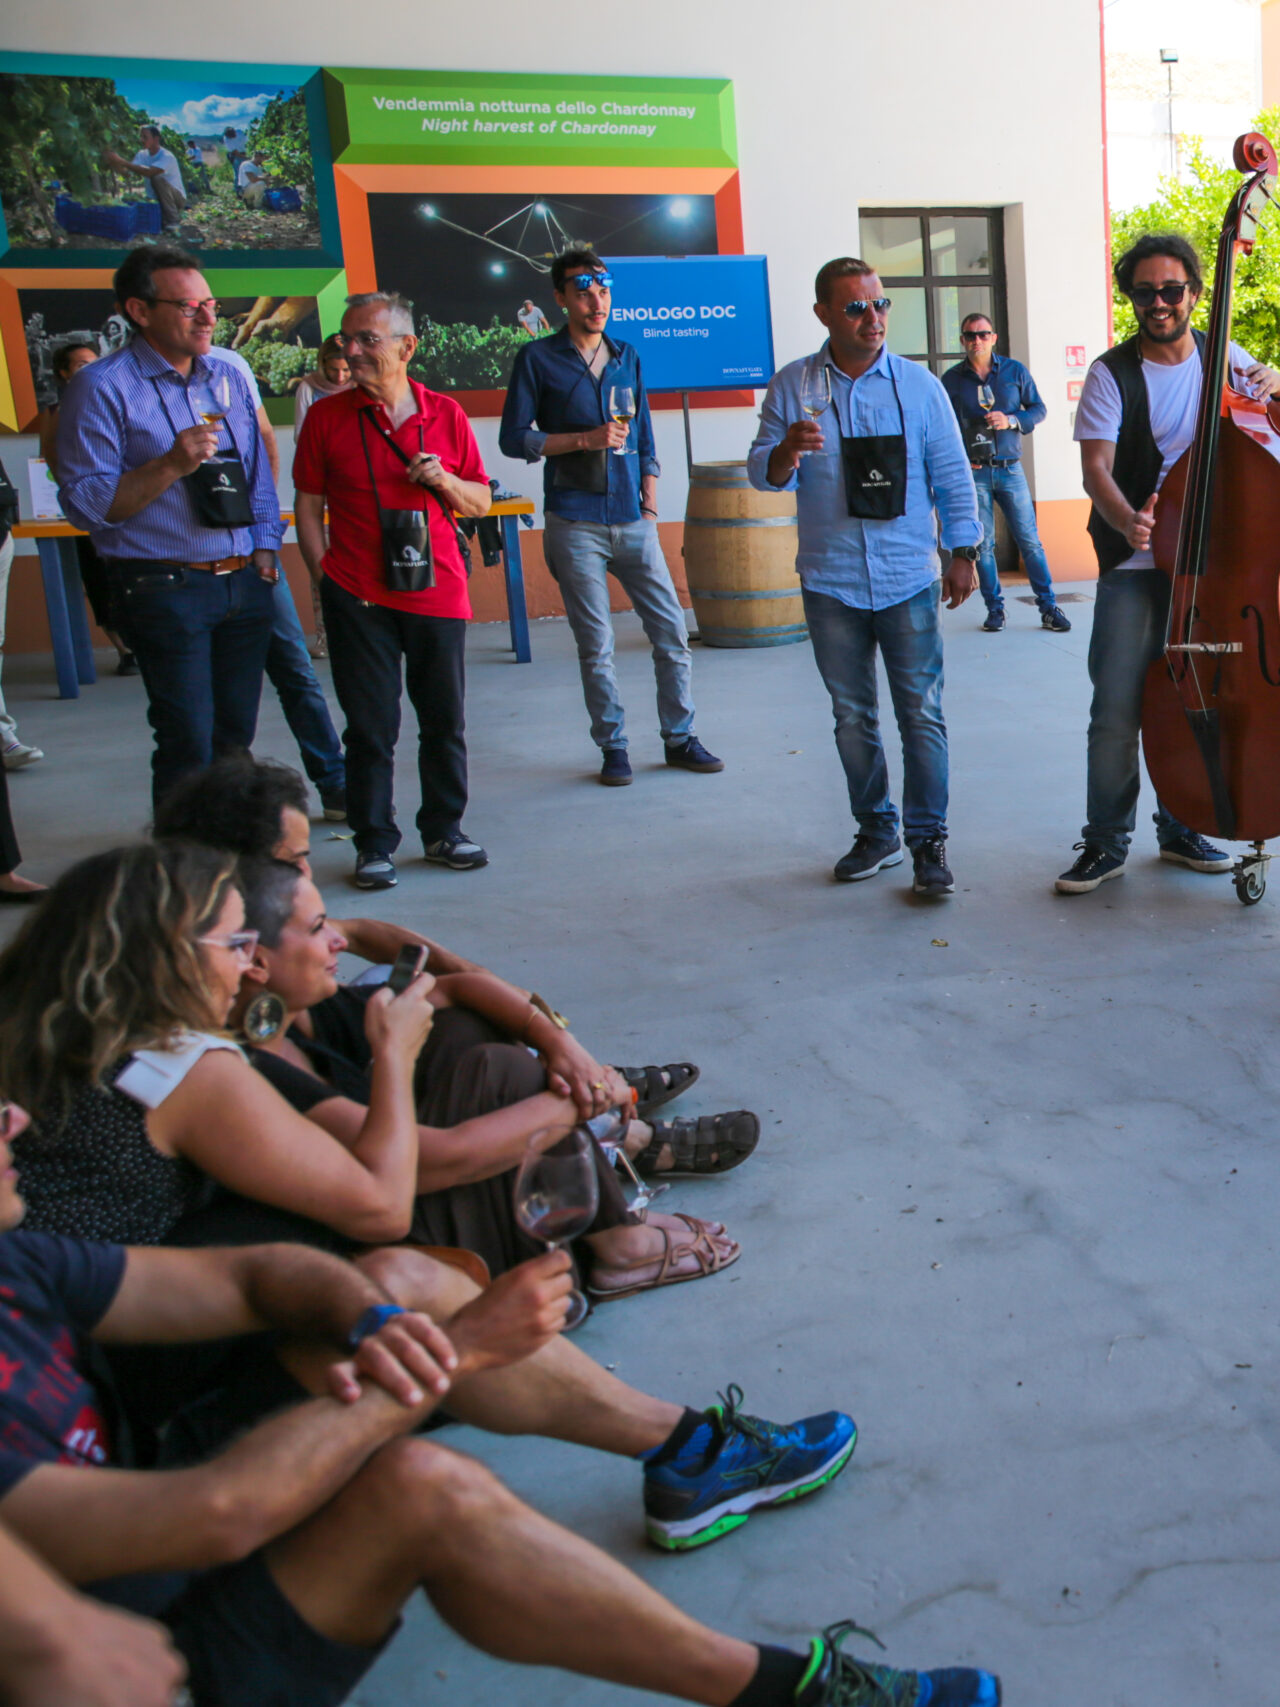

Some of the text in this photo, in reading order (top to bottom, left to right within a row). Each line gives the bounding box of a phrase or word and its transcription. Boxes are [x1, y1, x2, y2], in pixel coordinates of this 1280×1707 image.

[373, 96, 696, 119] Vendemmia notturna dello Chardonnay
[421, 118, 657, 137] Night harvest of Chardonnay
[612, 305, 736, 321] ENOLOGO DOC
[643, 327, 709, 338] Blind tasting
